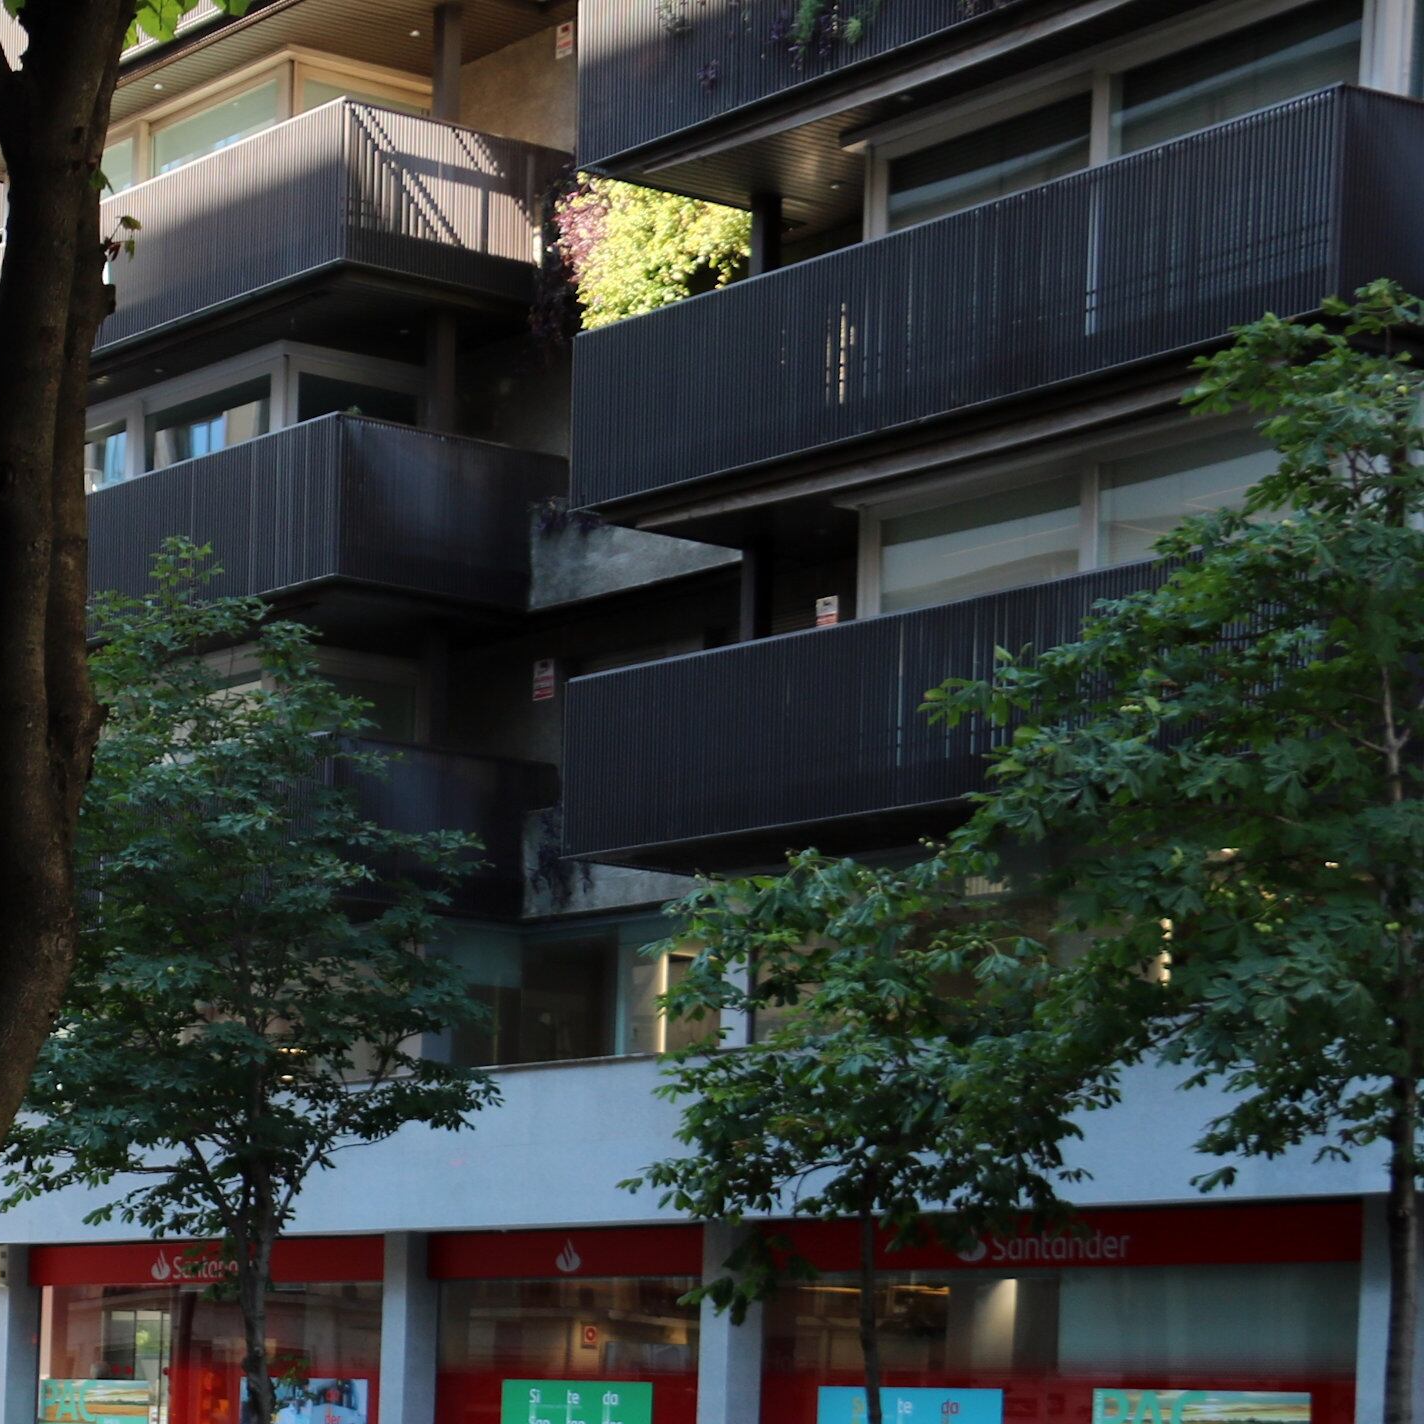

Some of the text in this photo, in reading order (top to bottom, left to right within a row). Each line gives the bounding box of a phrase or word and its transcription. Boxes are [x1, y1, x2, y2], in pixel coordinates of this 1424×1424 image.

[990, 1228, 1131, 1262] Santander
[566, 1389, 580, 1405] te
[602, 1390, 619, 1406] da
[896, 1398, 914, 1415] te
[940, 1400, 961, 1416] da
